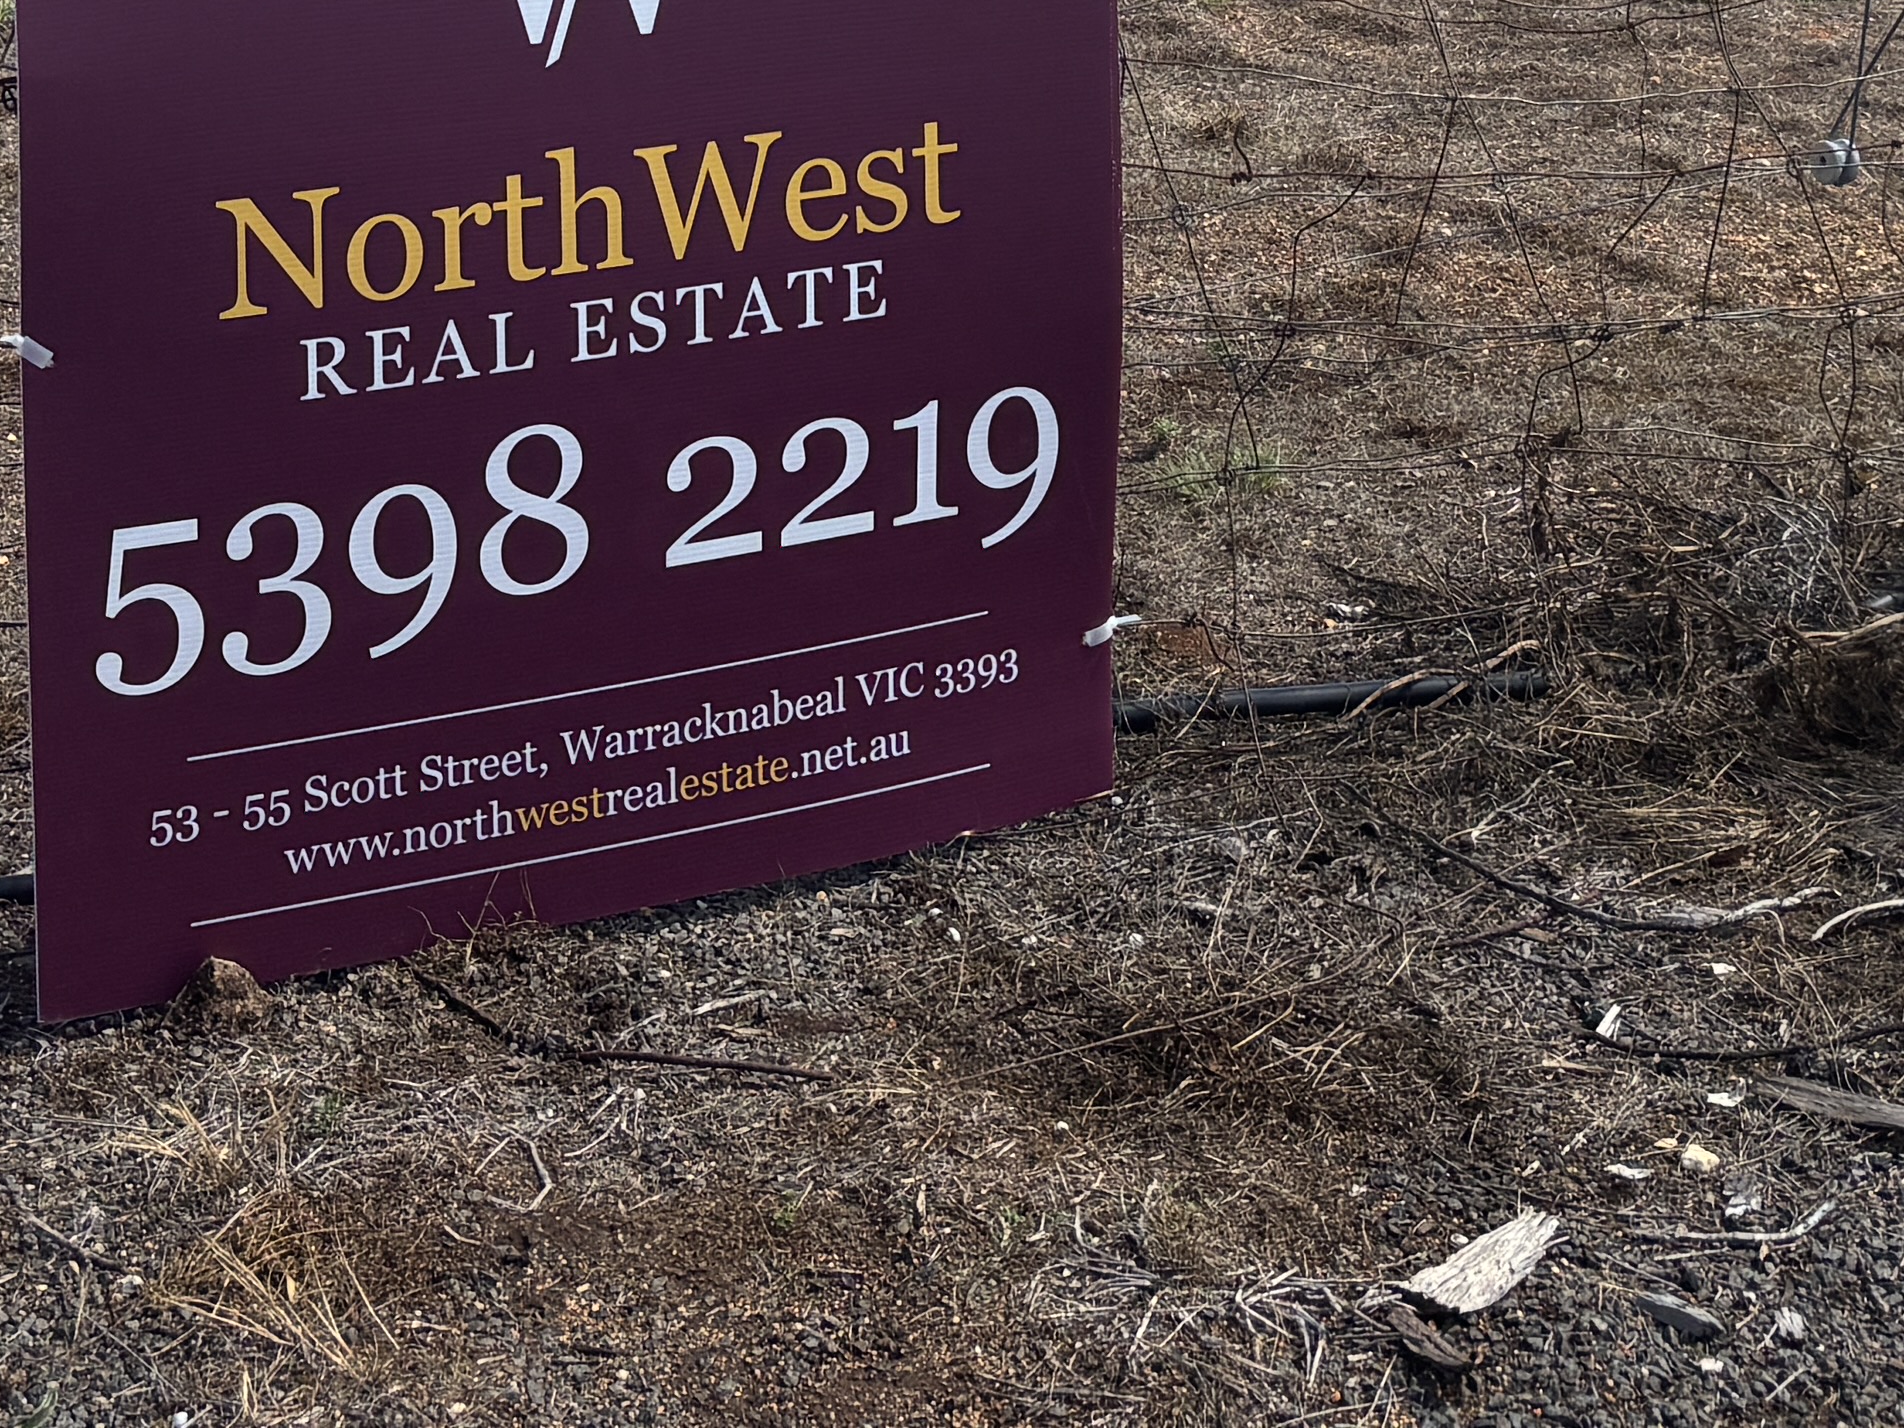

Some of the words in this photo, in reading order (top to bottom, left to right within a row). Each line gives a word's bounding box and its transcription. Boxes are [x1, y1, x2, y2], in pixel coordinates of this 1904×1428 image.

[215, 121, 961, 320] NorthWest
[299, 311, 535, 401] REAL
[569, 259, 887, 363] ESTATE
[95, 423, 589, 696] 5398
[665, 386, 1059, 568] 2219
[150, 805, 200, 847] 53
[242, 789, 291, 831] 55
[304, 764, 408, 812] Scott
[420, 741, 548, 792] Street,
[559, 675, 847, 765] Warracknabeal
[854, 661, 925, 706] VIC
[934, 648, 1019, 698] 3393
[283, 730, 911, 874] www.northwestrealestate.net.au
